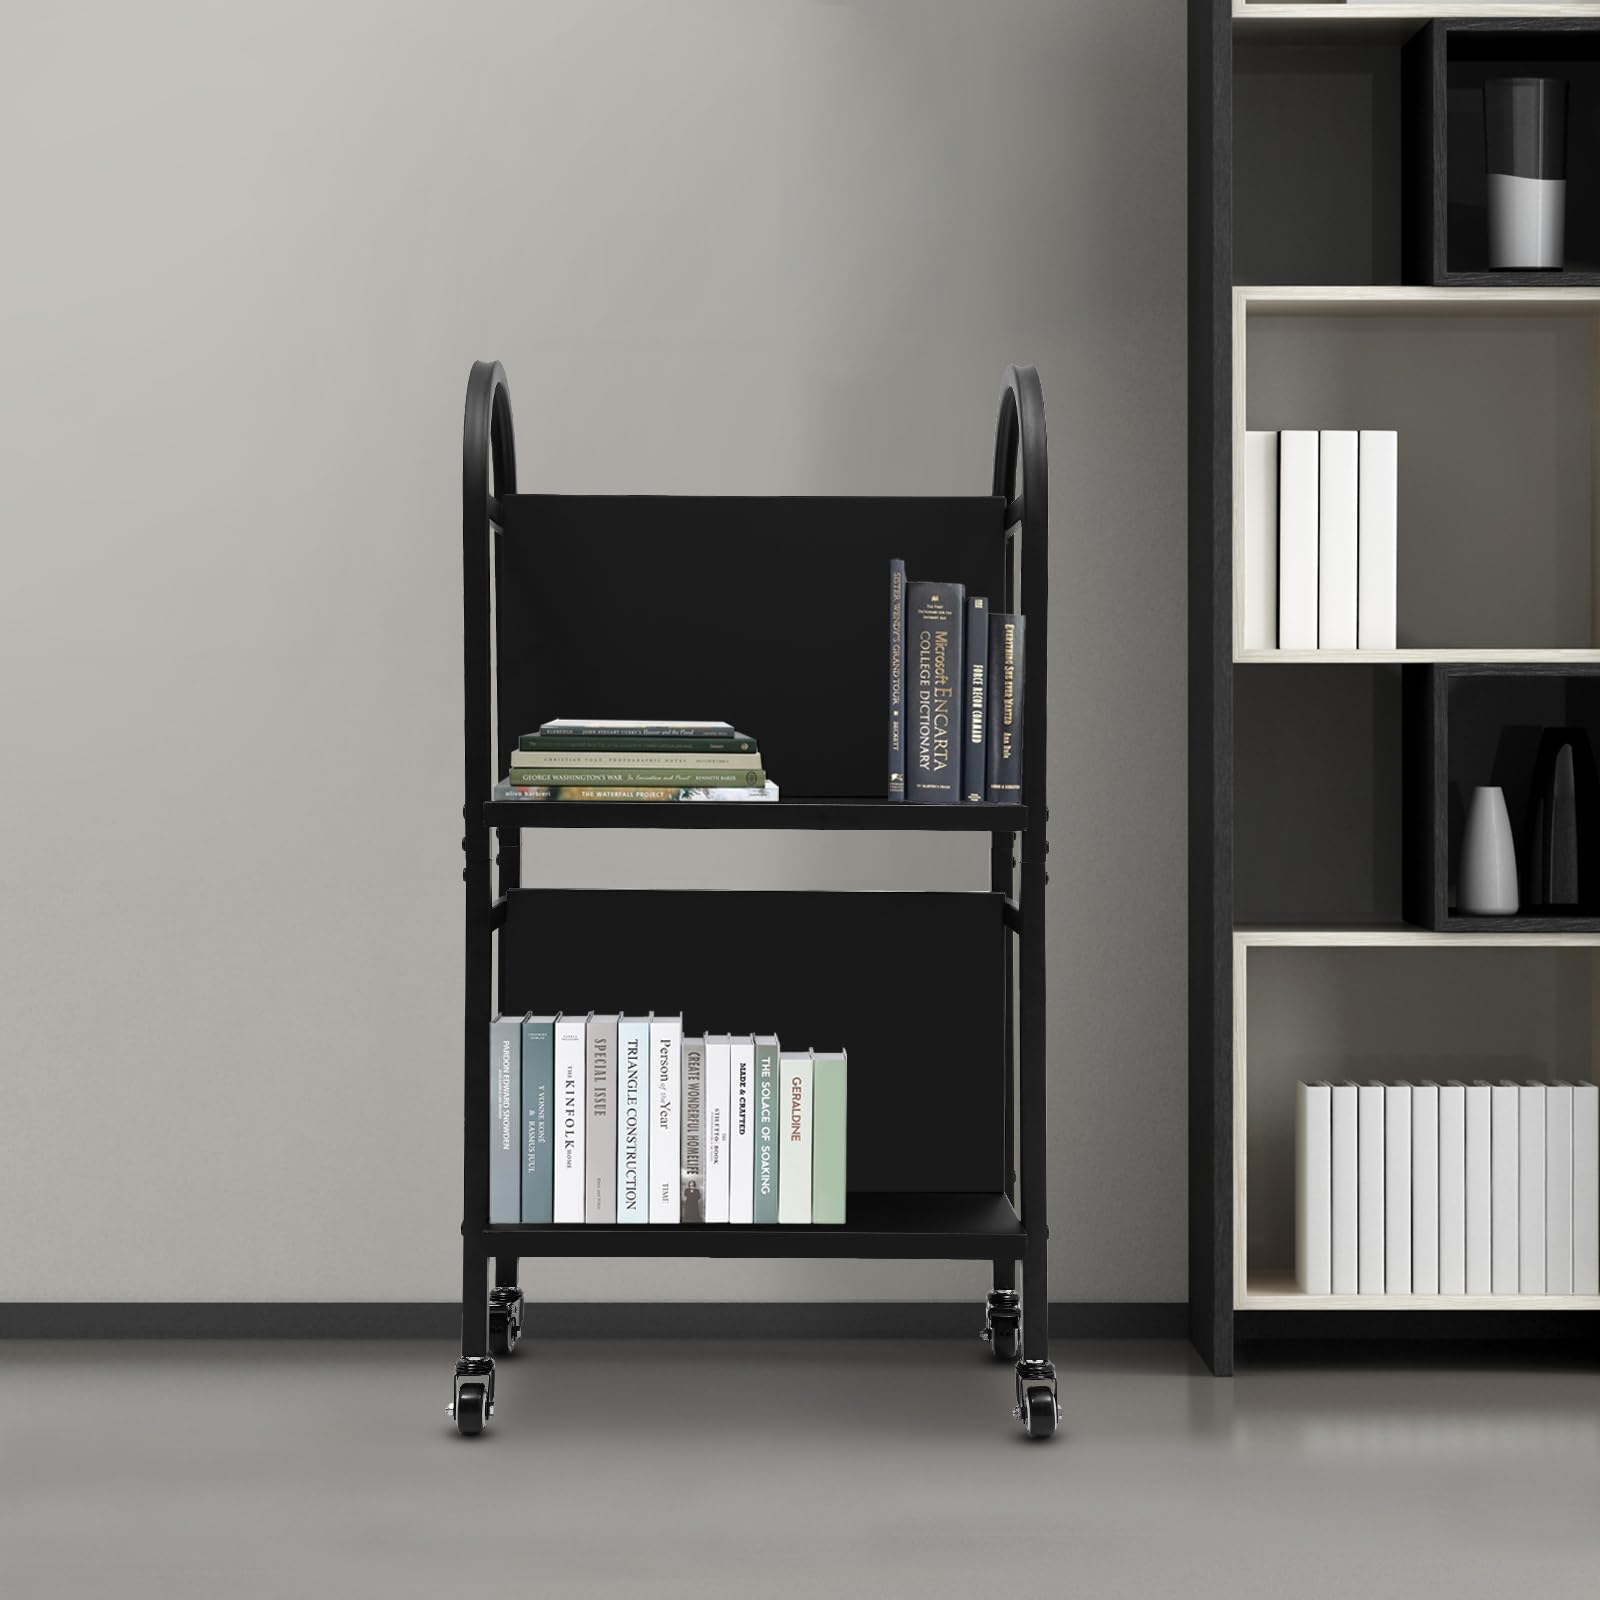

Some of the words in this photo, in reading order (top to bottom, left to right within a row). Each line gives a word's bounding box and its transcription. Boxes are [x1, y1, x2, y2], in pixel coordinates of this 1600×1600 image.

[893, 572, 901, 601] SISTER
[892, 644, 900, 678] GRAND
[920, 631, 931, 686] COLLEGE
[935, 631, 948, 685] Microsoft
[972, 664, 983, 685] FORCE
[892, 679, 900, 705] TOUR
[972, 687, 983, 708] RECON
[920, 690, 931, 770] DICTIONARY
[934, 687, 952, 771] ENCARTA
[971, 710, 982, 743] COMMAND
[594, 1038, 606, 1083] SPECIAL
[627, 1039, 638, 1105] TRIANGLE
[660, 1039, 671, 1082] Person
[688, 1051, 700, 1081] CREATE
[739, 1062, 747, 1088] MADE
[761, 1056, 771, 1077] THE
[594, 1087, 606, 1117] ISSUE
[659, 1082, 666, 1091] of
[761, 1081, 771, 1123] SOLACE
[565, 1080, 575, 1149] KINFOLK
[660, 1102, 671, 1130] Year
[688, 1084, 700, 1132] WONDERFUL
[791, 1076, 802, 1142] GERALDINE
[761, 1126, 771, 1142] OF
[625, 1107, 638, 1210] CONSTRUCTION
[687, 1135, 699, 1175] HOMELIFE
[760, 1145, 771, 1195] SOAKING
